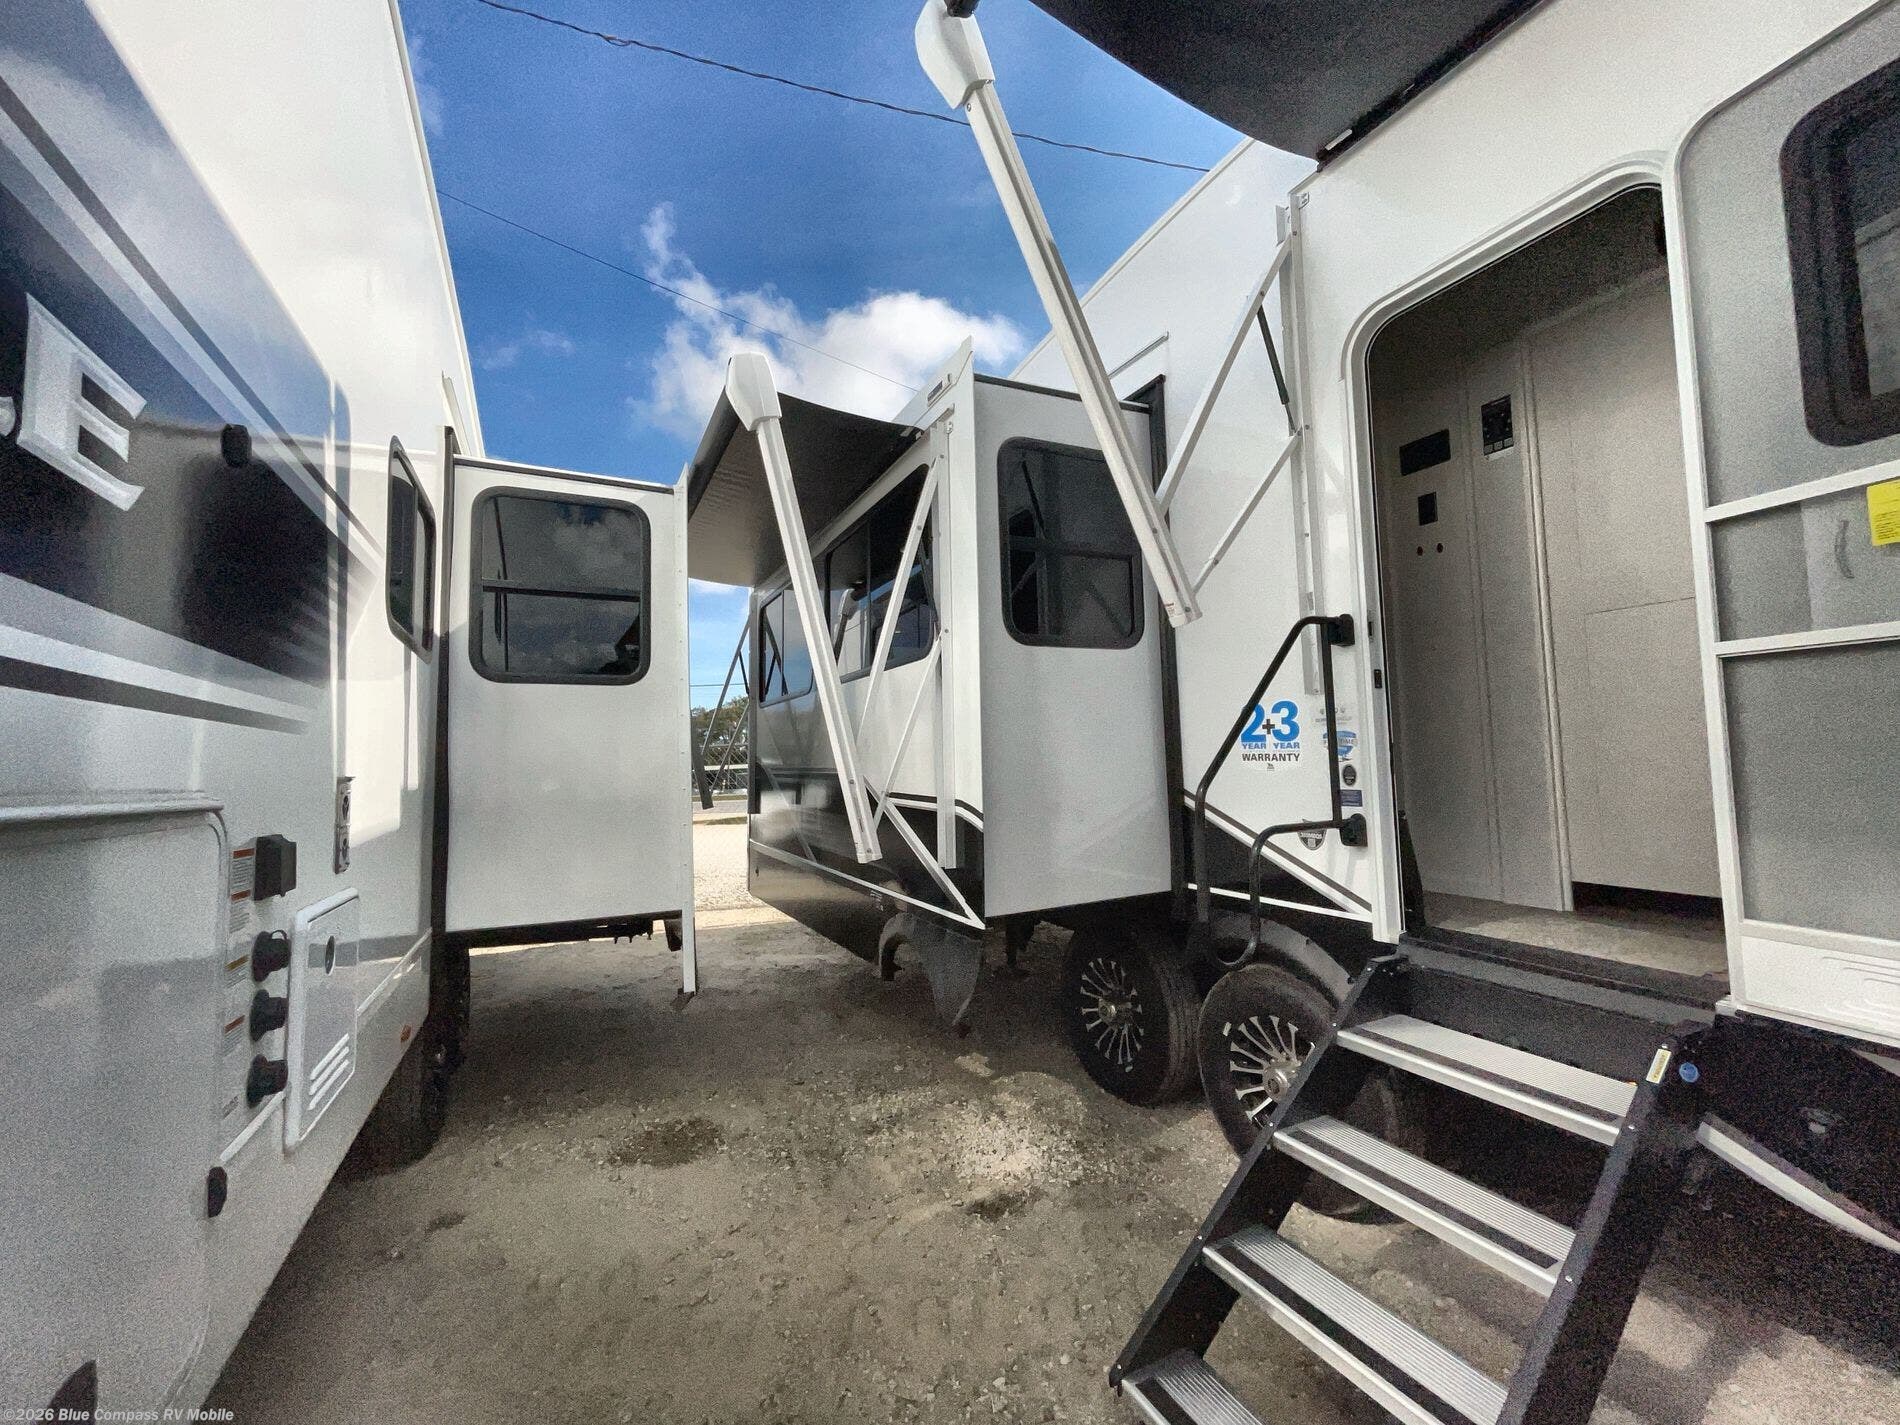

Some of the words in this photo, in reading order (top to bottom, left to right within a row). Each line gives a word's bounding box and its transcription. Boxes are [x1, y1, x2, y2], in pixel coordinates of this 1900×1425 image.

[0, 292, 147, 511] E
[1242, 742, 1266, 750] YEAR
[1242, 753, 1300, 762] WARRANTY
